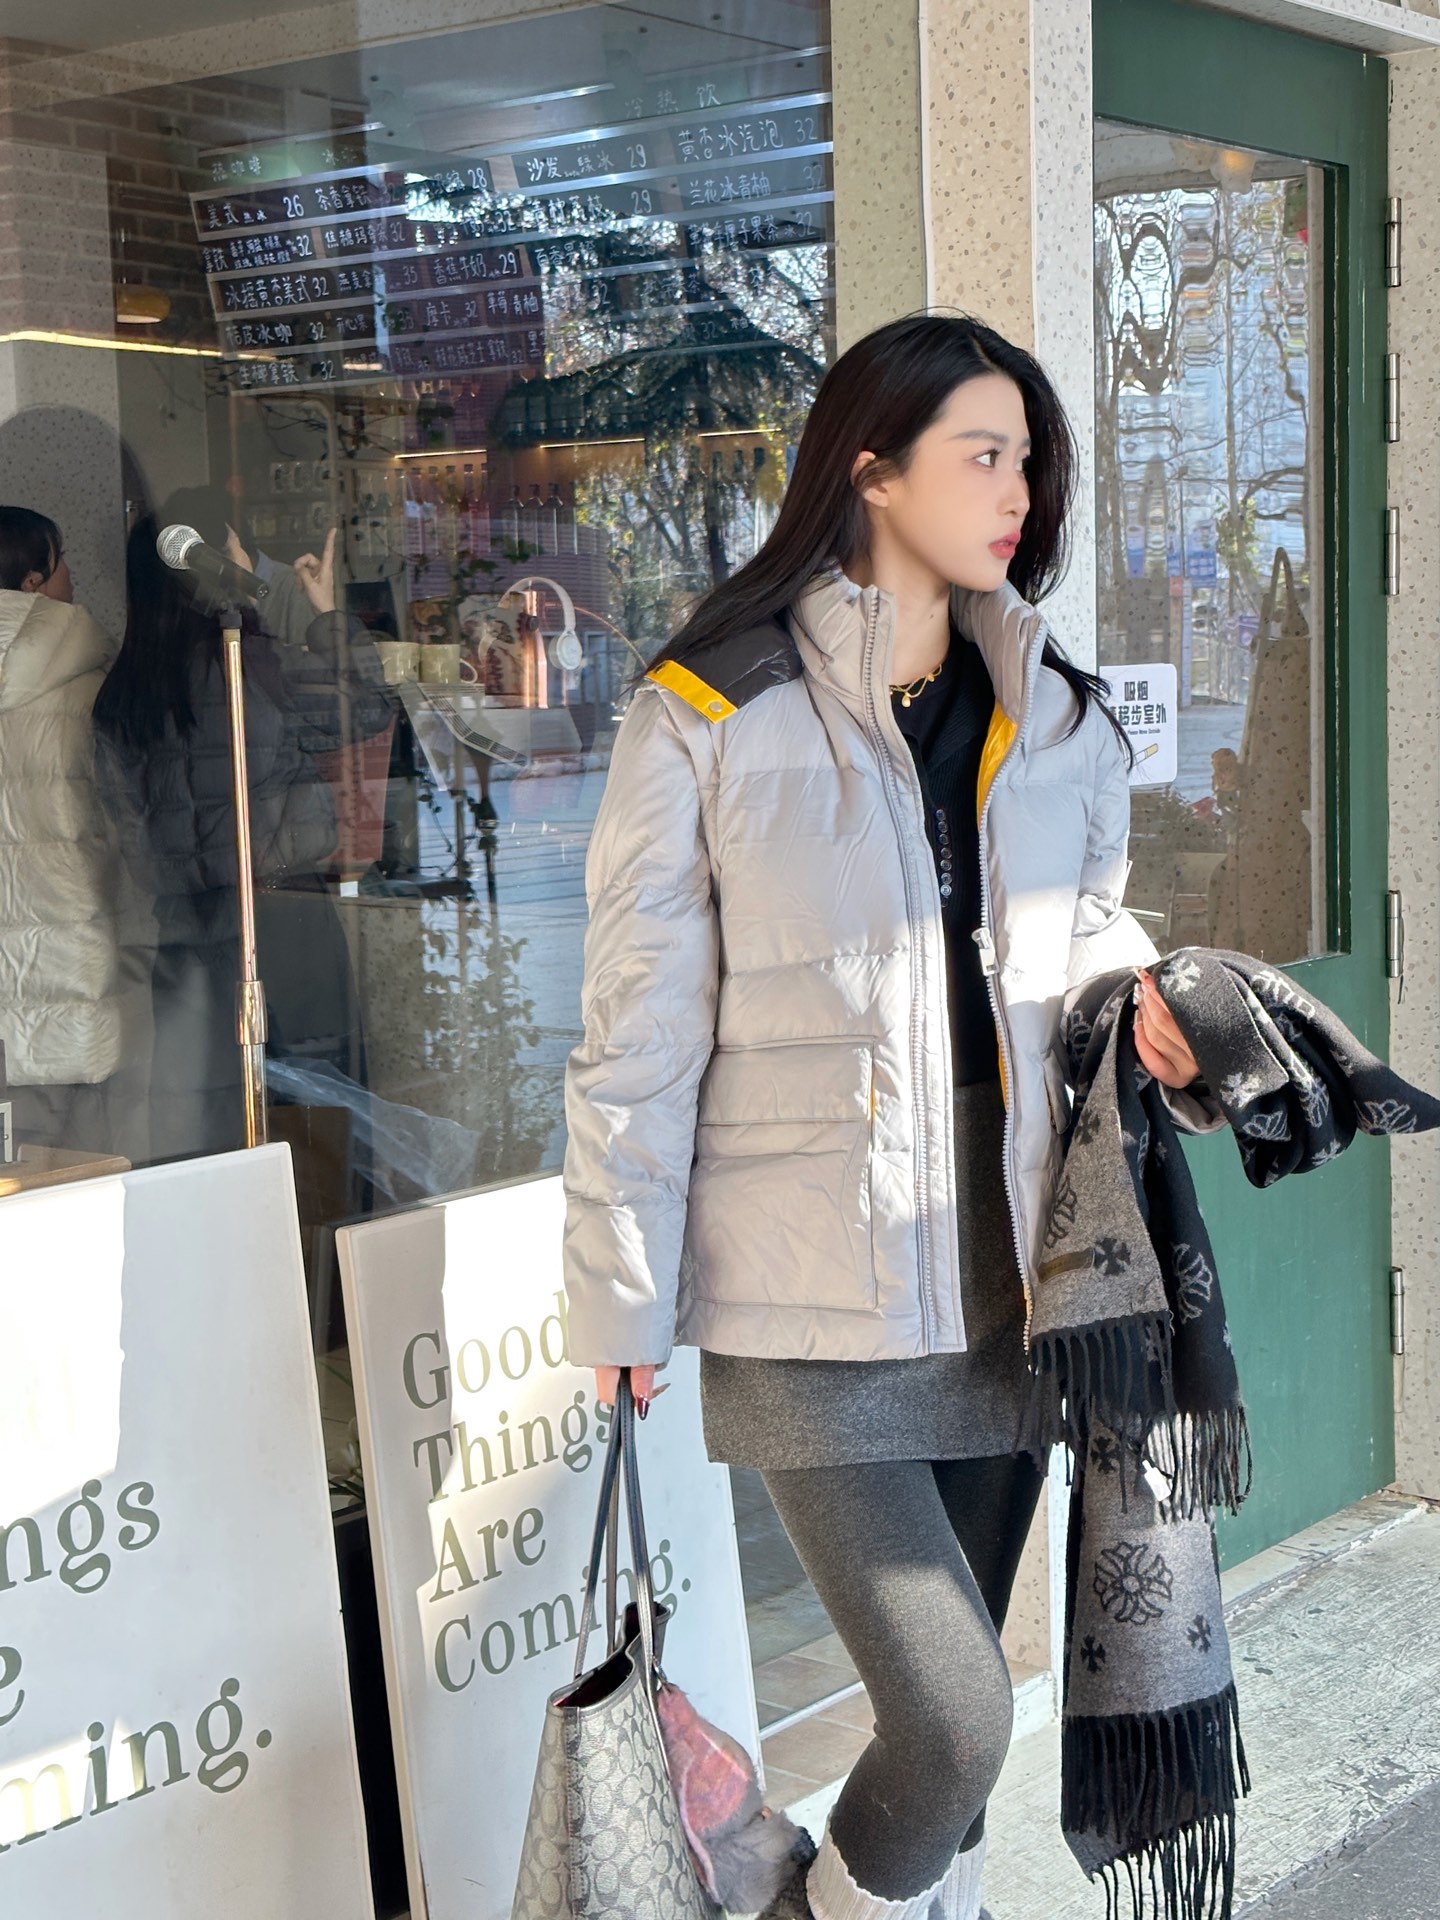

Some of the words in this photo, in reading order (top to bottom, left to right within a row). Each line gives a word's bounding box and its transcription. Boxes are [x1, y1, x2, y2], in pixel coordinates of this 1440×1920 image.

[794, 117, 819, 144] 32
[526, 156, 562, 182] 沙发
[625, 143, 648, 169] 29
[467, 166, 487, 190] 28
[802, 164, 826, 192] 32
[206, 201, 240, 229] 美式
[282, 194, 305, 219] 26
[630, 188, 653, 215] 29
[389, 221, 406, 243] 32
[796, 210, 817, 238] 32
[295, 233, 313, 258] 32
[402, 264, 419, 287] 35
[499, 251, 518, 275] 29
[311, 276, 330, 298] 32
[309, 321, 327, 341] 32
[320, 359, 337, 381] 32
[1124, 680, 1149, 702] 吸烟
[403, 1290, 570, 1410] Good
[413, 1389, 613, 1504] Things
[429, 1507, 546, 1603] Are
